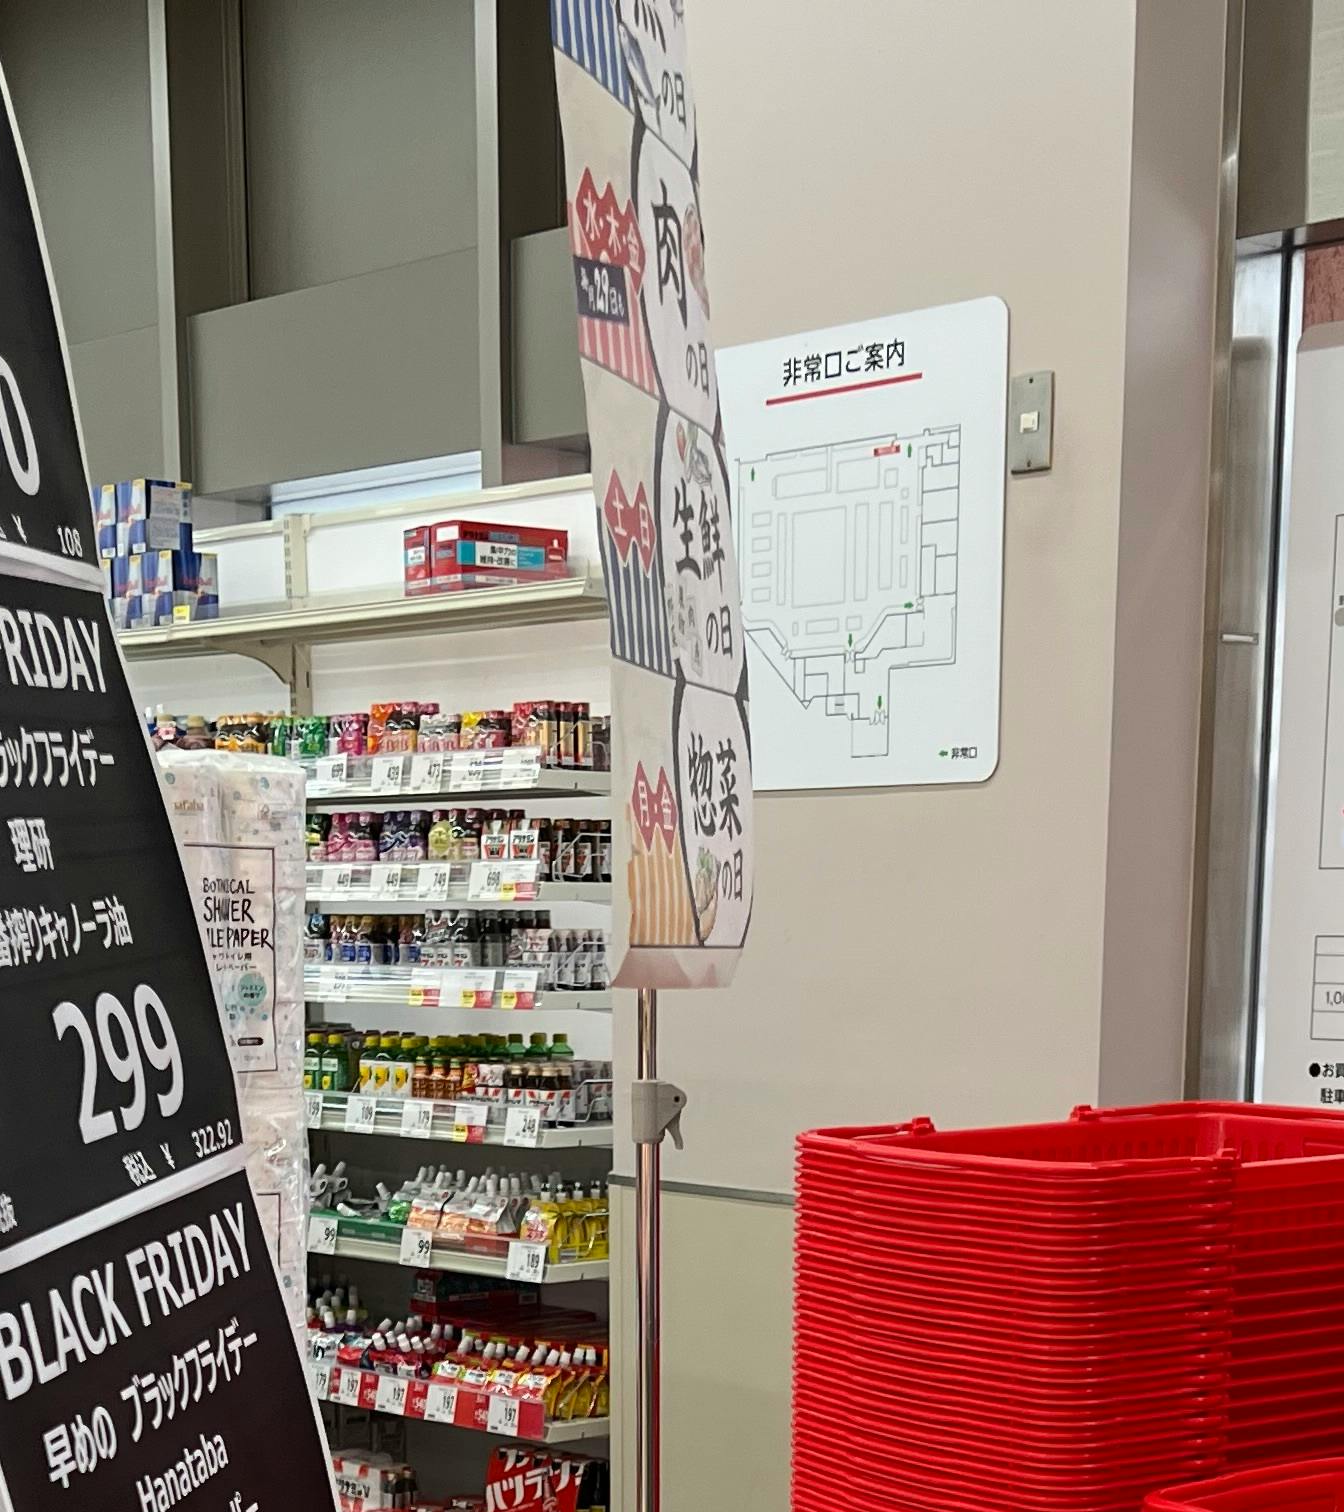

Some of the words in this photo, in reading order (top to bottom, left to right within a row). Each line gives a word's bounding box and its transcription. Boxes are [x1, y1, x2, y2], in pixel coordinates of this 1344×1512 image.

[650, 178, 688, 330] 肉
[686, 341, 709, 399] の日
[781, 338, 906, 388] 非常口ご案内
[57, 525, 84, 558] 108
[672, 477, 726, 593] 生鮮
[705, 605, 733, 660] の日
[687, 731, 743, 842] 惣菜
[7, 817, 54, 873] 理研
[721, 848, 743, 901] の日
[53, 984, 185, 1144] 299
[122, 1153, 156, 1187] 税込
[192, 1119, 234, 1158] 322.92
[128, 1203, 254, 1328] FRIDAY
[417, 1239, 430, 1255] 99
[45, 1404, 119, 1489] 早めの
[120, 1317, 259, 1442] ブラックフライデー
